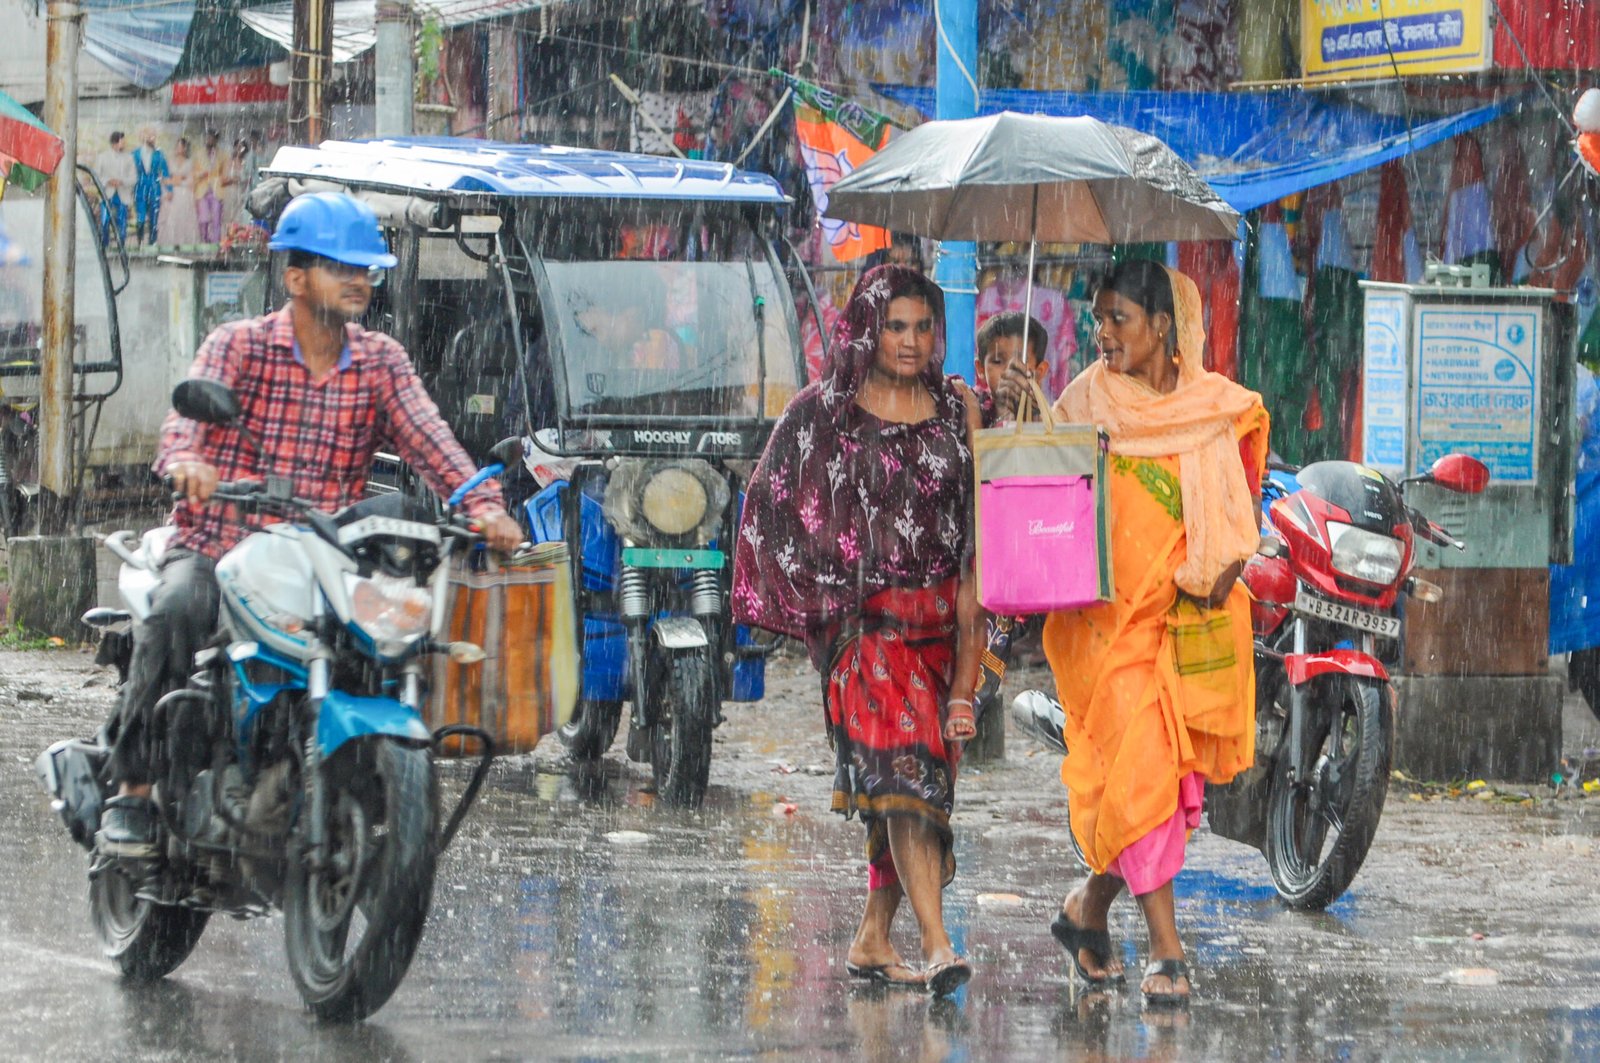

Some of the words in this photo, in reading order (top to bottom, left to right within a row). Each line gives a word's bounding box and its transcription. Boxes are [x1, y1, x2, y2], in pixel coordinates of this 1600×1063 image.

[1431, 359, 1480, 367] HARDWARE
[1430, 372, 1489, 381] NETWORKING
[633, 430, 692, 444] HOOGHLY
